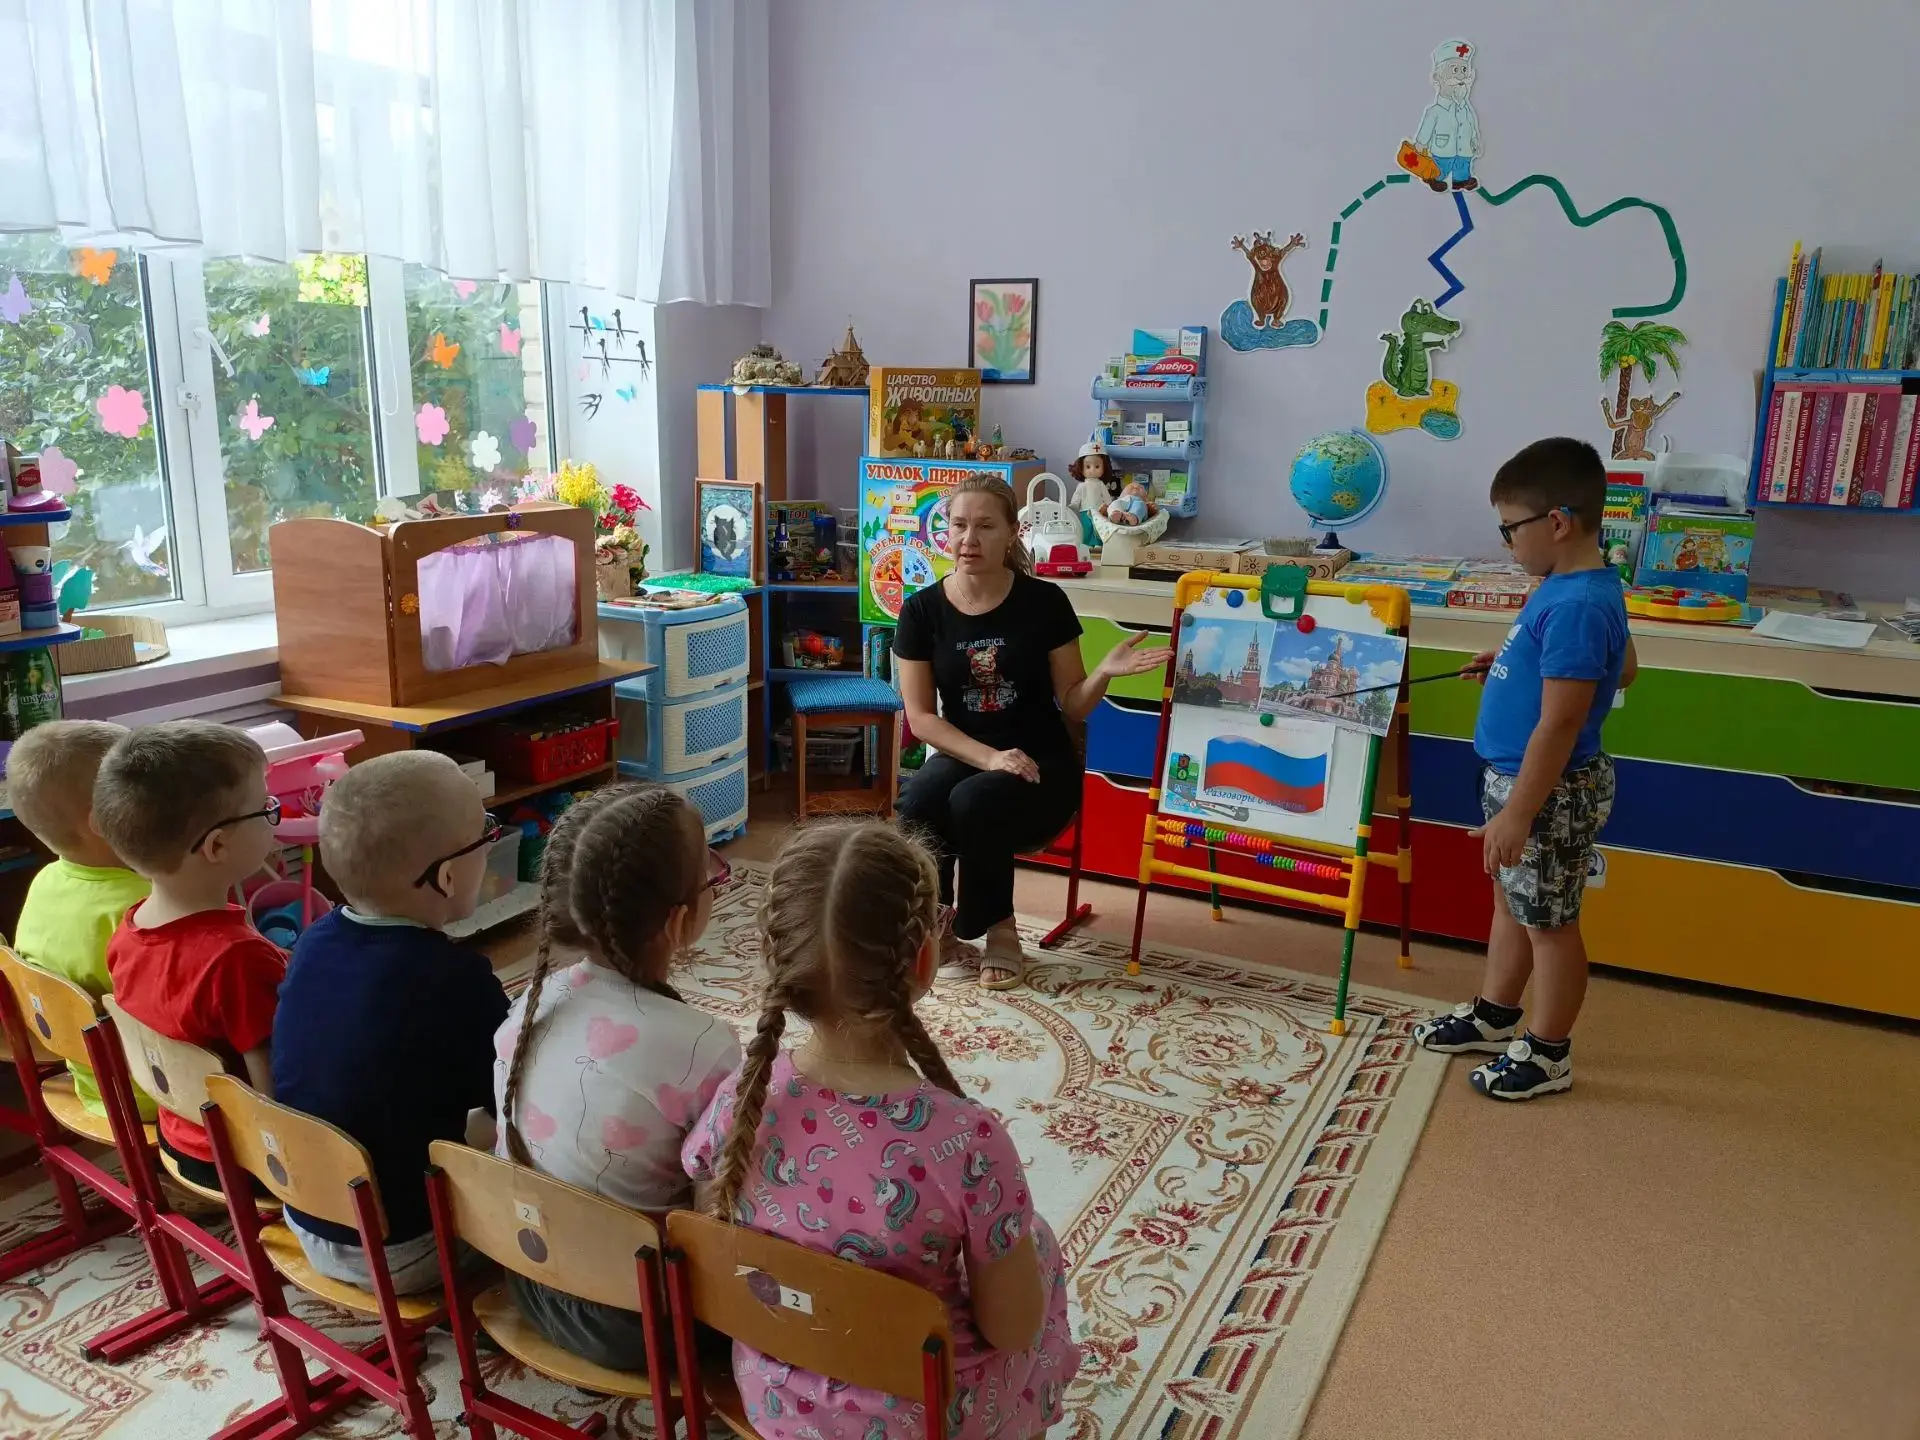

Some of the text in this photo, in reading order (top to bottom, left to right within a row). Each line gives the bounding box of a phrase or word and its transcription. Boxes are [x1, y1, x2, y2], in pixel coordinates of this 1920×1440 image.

[1800, 263, 1809, 290] Стихи
[1155, 361, 1194, 372] Colgate
[887, 374, 936, 386] ЦАРСТВО
[884, 386, 978, 407] ЖИВОТНЫХ
[866, 464, 924, 481] УГОЛОК
[1820, 469, 1831, 498] СКАЗКИ
[1602, 510, 1629, 519] НИК
[869, 535, 936, 563] ВРЕМЯ ГОДА
[956, 637, 1006, 650] BEARBRICK
[1206, 788, 1255, 804] Разговоры
[825, 1103, 865, 1149] LOVE
[523, 1207, 531, 1220] 2
[752, 1183, 788, 1228] LOVE
[791, 1293, 801, 1307] 2
[981, 1376, 997, 1425] LOVE
[895, 1402, 926, 1429] OVE
